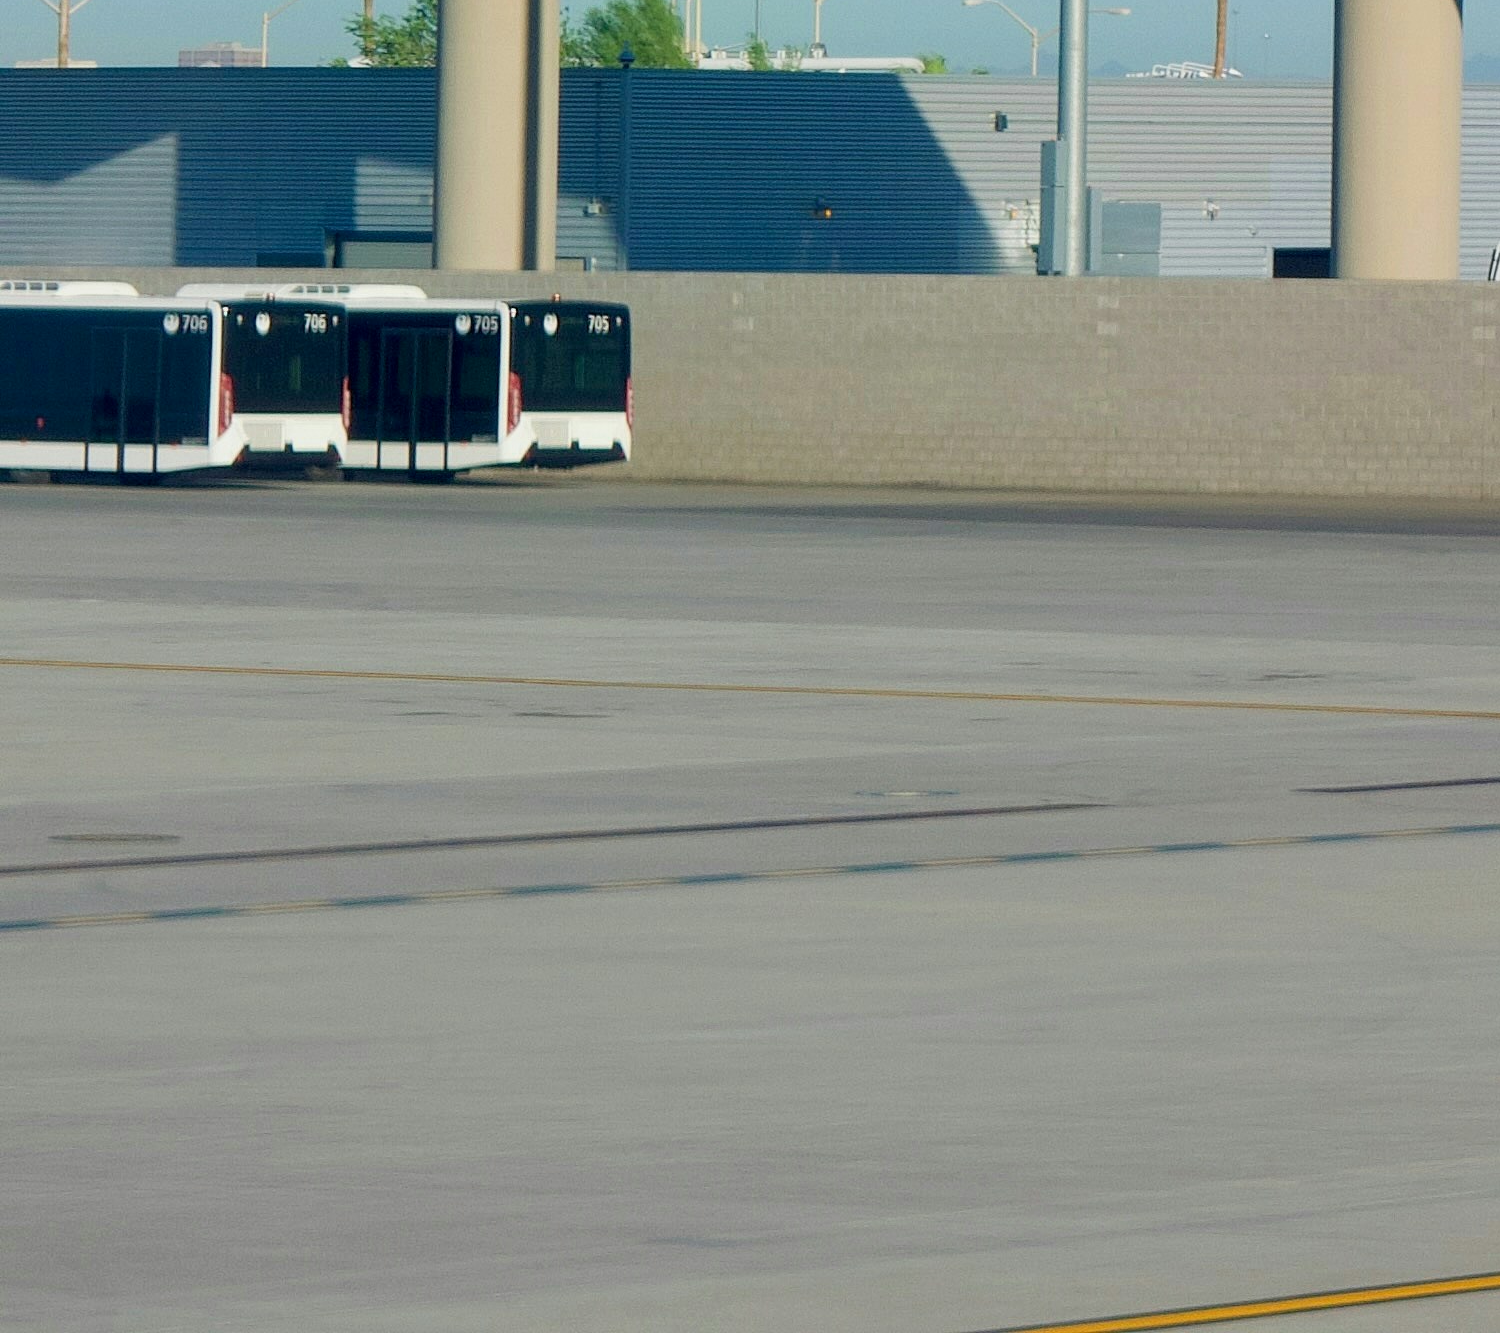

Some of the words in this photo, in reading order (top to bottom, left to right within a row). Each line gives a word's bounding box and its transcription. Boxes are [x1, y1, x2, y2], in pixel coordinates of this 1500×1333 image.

[182, 314, 208, 333] 706
[304, 313, 327, 333] 706
[473, 315, 499, 334] 705
[588, 314, 610, 334] 705
